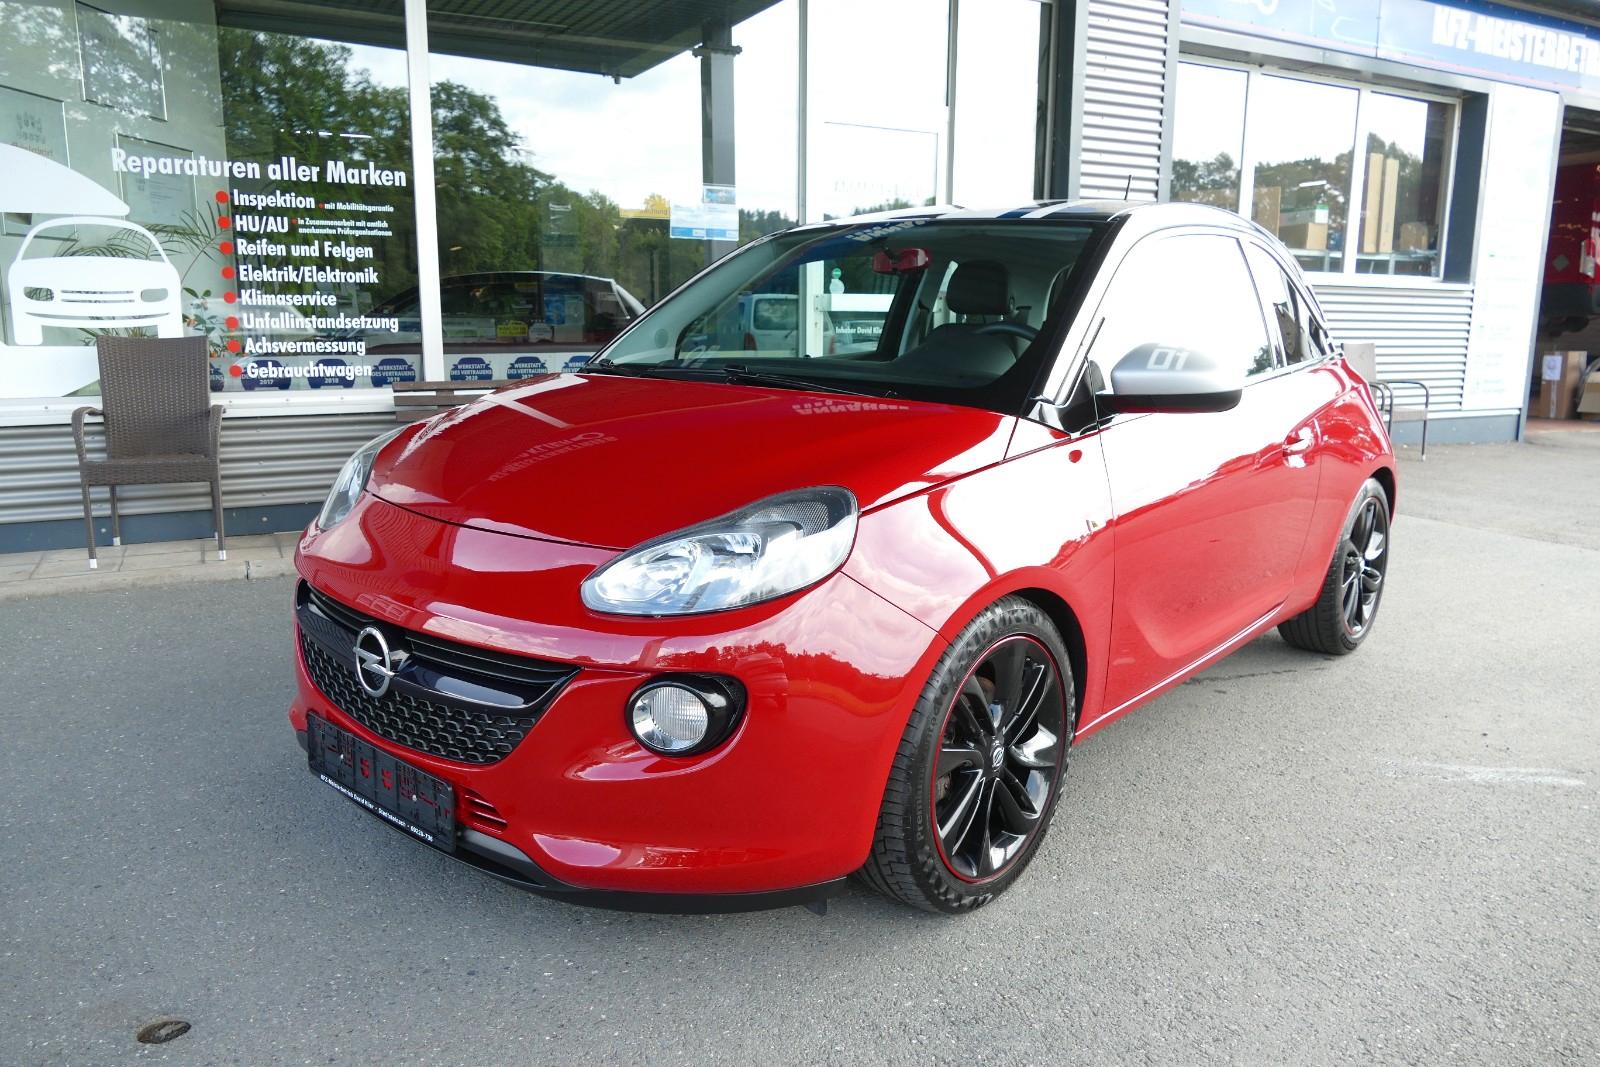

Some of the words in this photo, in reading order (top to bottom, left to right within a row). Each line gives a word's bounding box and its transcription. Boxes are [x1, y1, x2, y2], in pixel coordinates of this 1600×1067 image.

[111, 148, 261, 179] Reparaturen
[268, 157, 320, 182] aller
[327, 160, 406, 187] Marken
[233, 189, 315, 210] Inspektion
[325, 202, 335, 210] mit
[235, 215, 289, 234] HU/AU
[237, 239, 286, 256] Reifen
[291, 240, 319, 257] und
[324, 241, 373, 262] Felgen
[239, 265, 379, 284] Elektrik/Elektronik
[241, 289, 337, 306] Klimaservice
[242, 312, 399, 333] Unfallinstandsetzung
[245, 337, 366, 356] Achsvermessung
[1147, 348, 1190, 371] 01
[247, 361, 372, 380] Gebrauchtwagen
